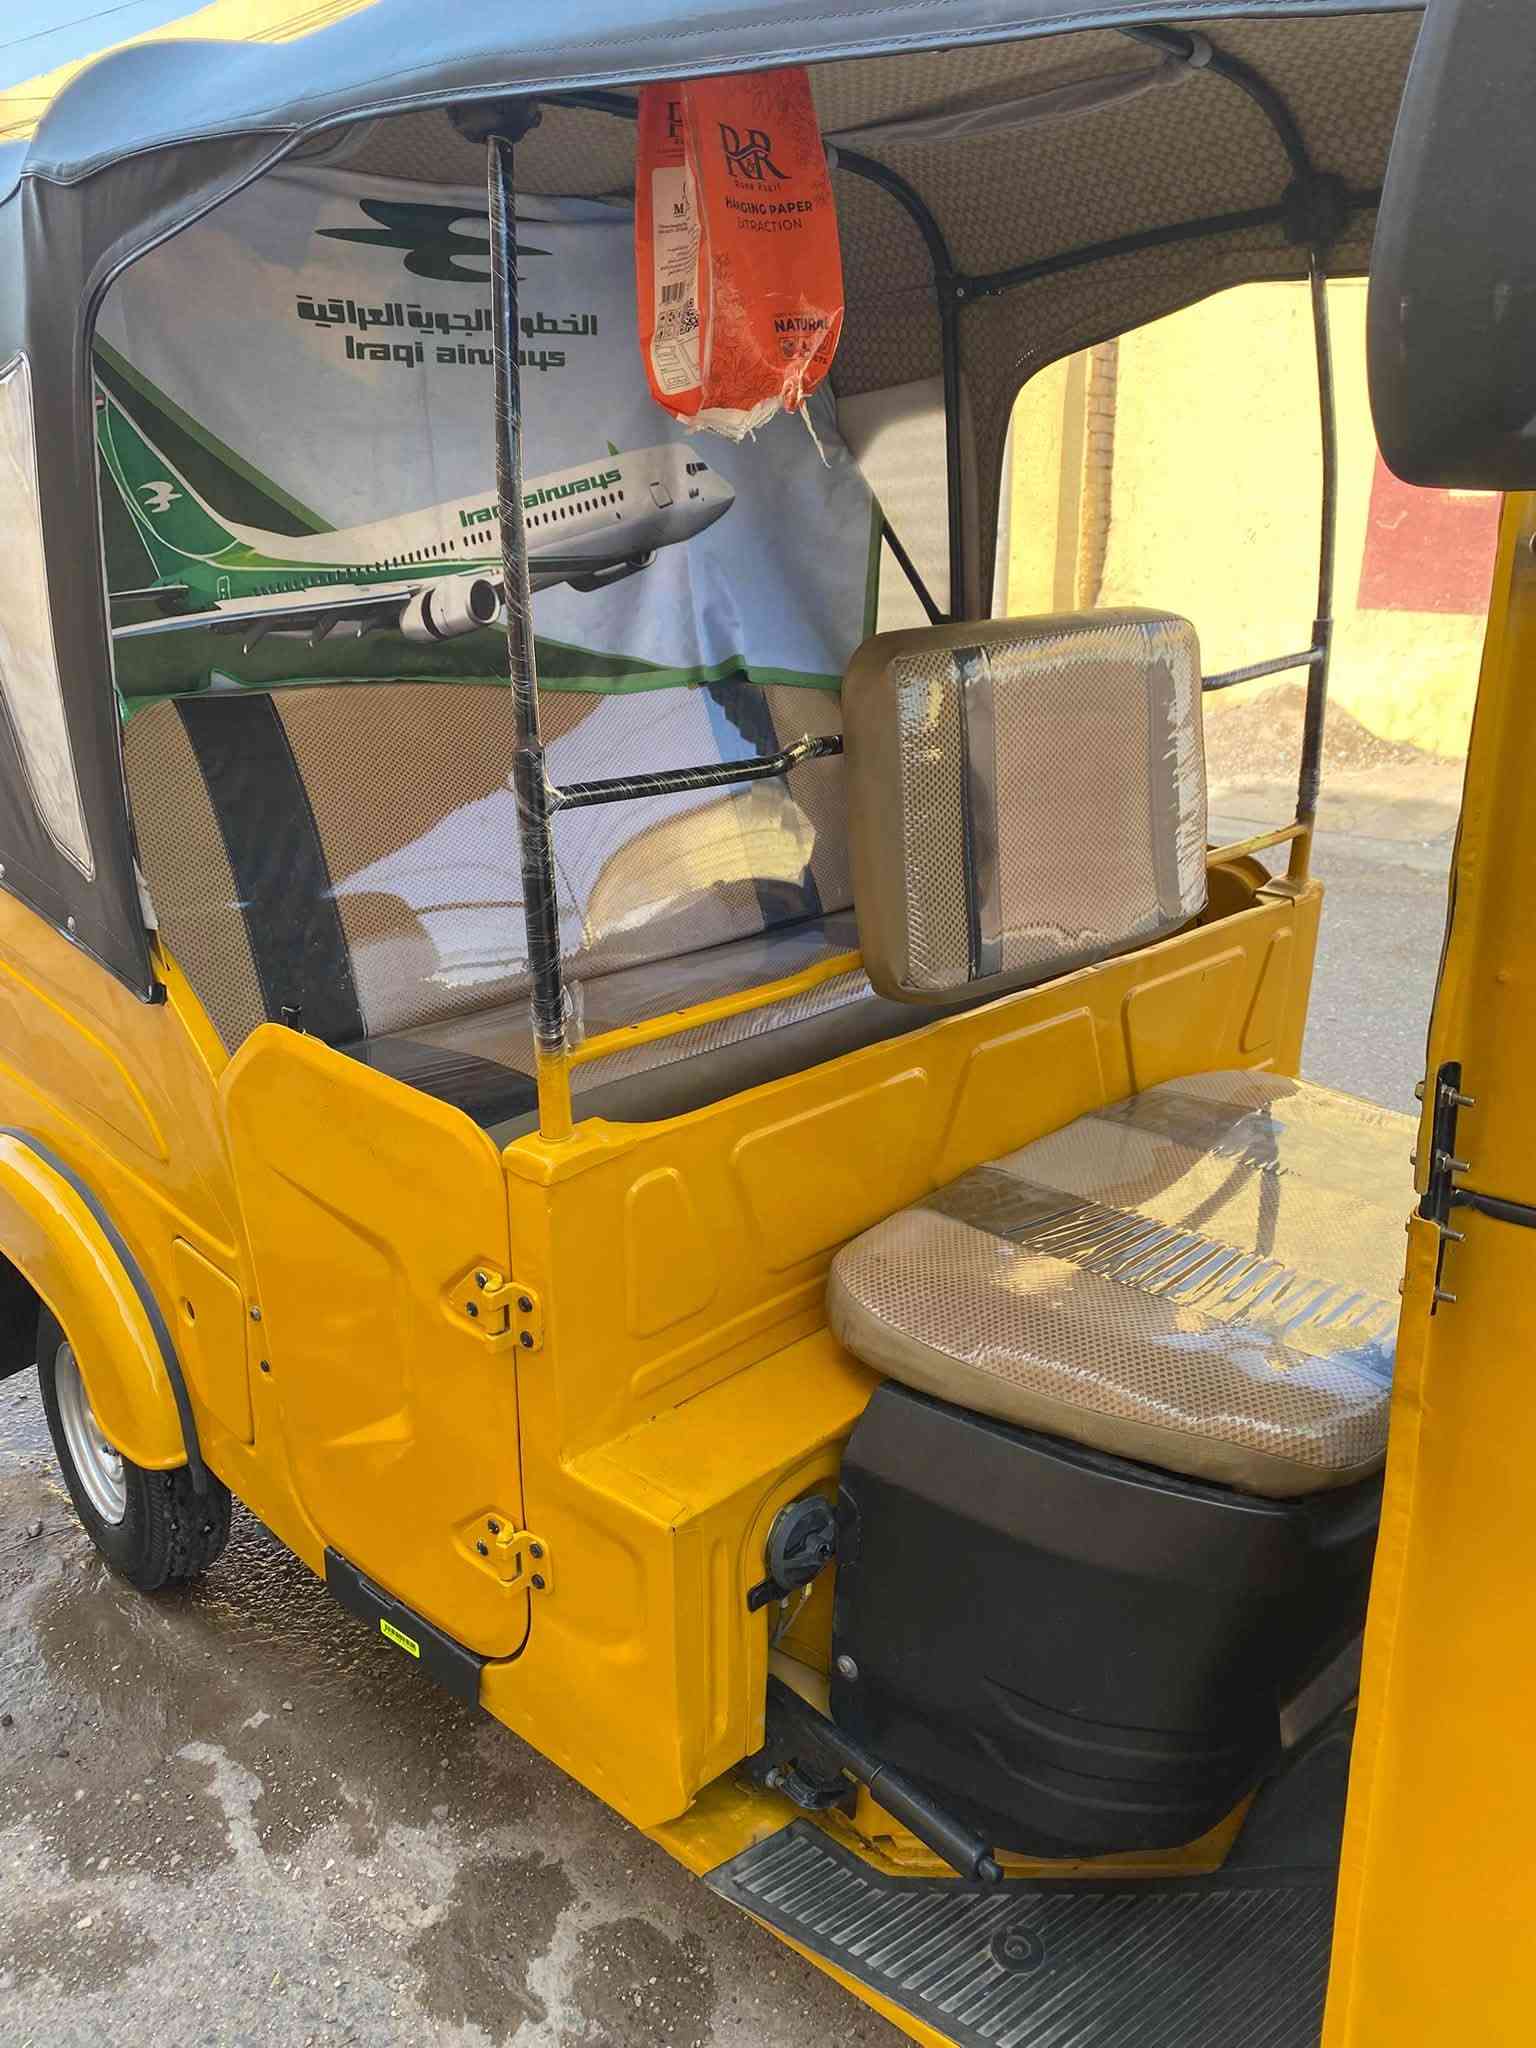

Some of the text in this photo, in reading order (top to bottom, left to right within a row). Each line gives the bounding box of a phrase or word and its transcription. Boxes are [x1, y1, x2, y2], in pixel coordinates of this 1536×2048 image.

[769, 200, 814, 216] PAPER
[296, 294, 598, 337] الخطو الجوية العراقية
[774, 317, 829, 332] NATURAL
[345, 336, 424, 368] Iraqi
[459, 469, 622, 527] Ira airways
